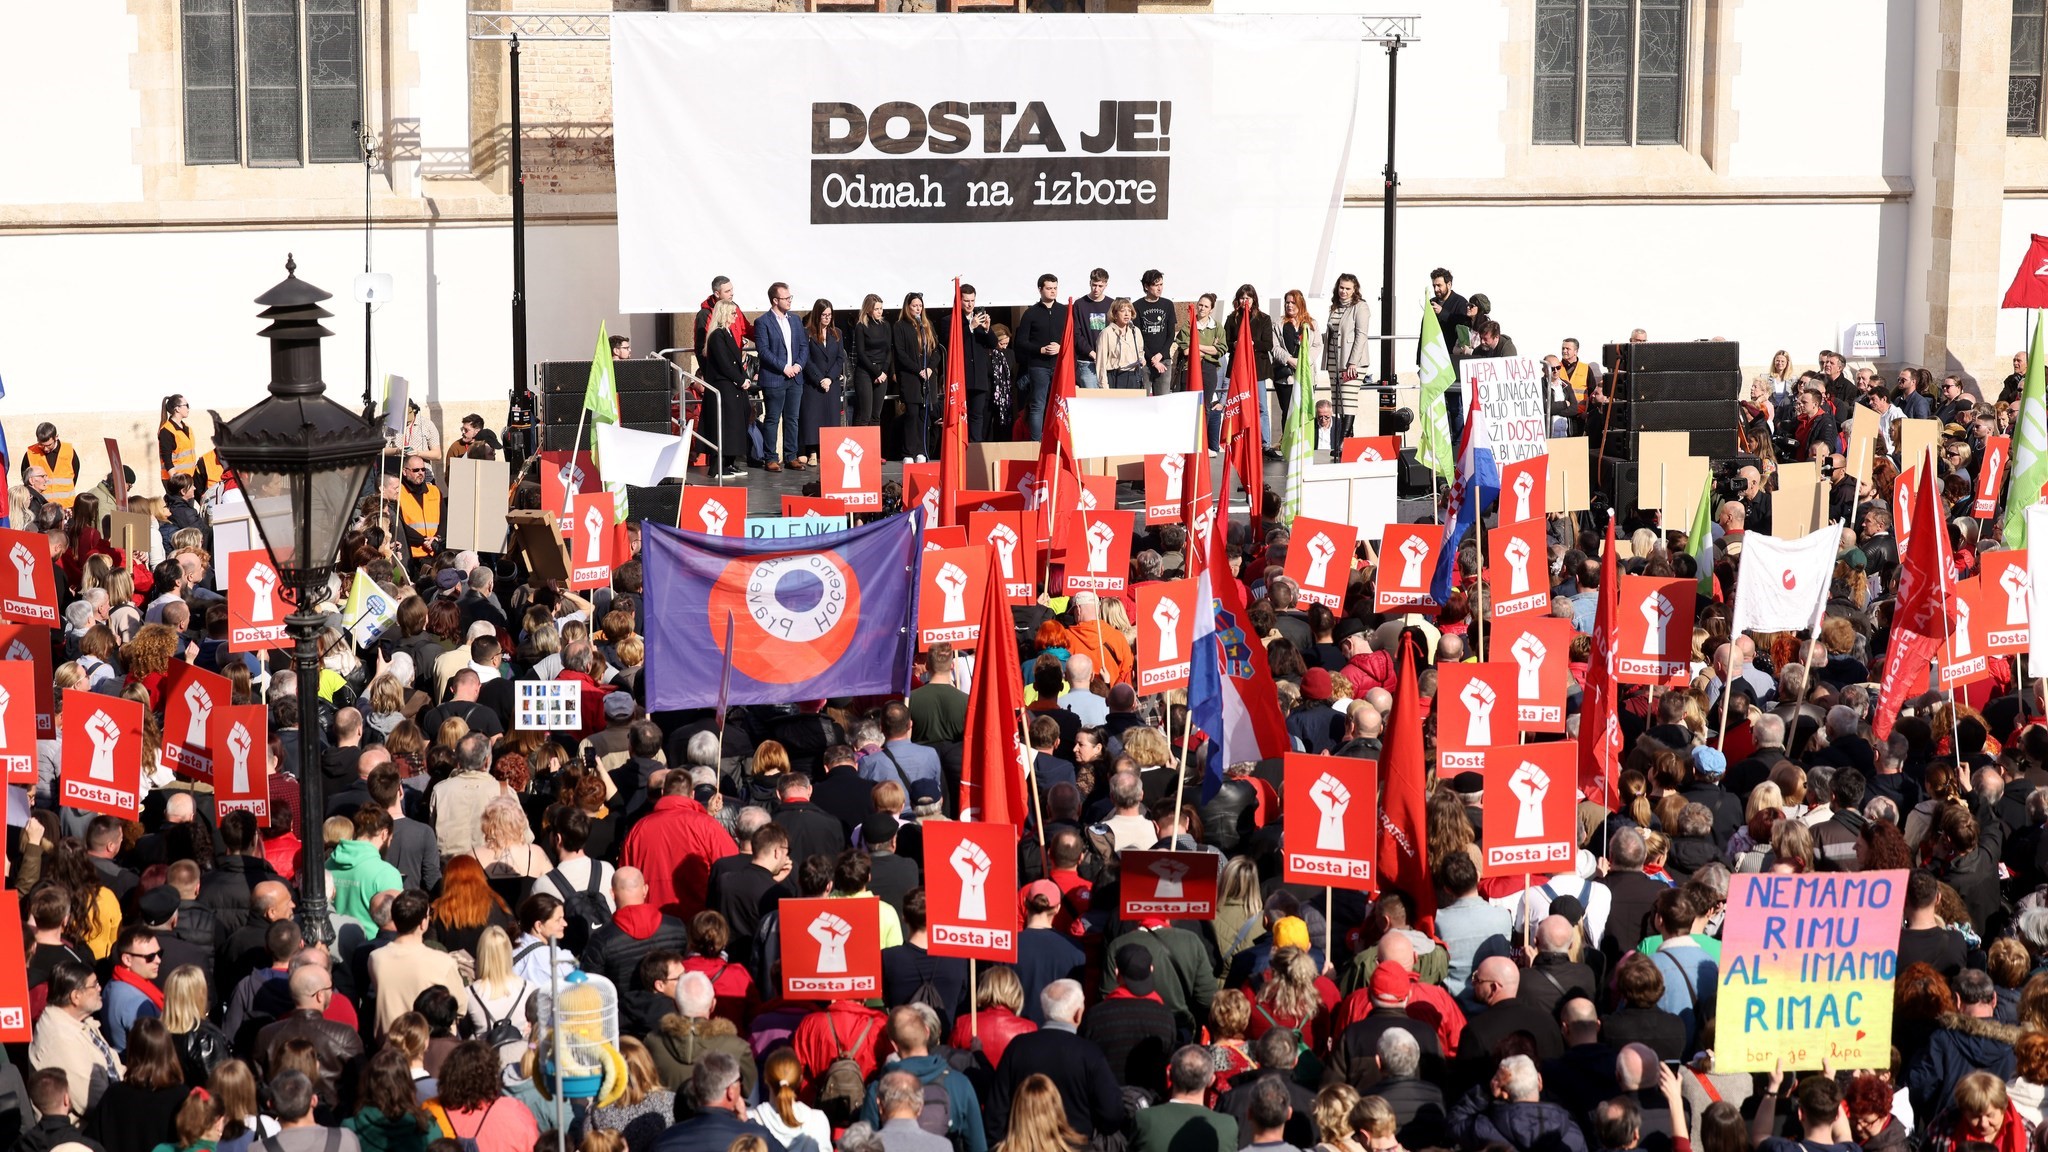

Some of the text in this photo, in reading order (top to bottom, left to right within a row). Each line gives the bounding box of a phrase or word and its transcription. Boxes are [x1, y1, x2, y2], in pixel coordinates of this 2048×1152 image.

[811, 100, 1172, 155] DOSTA JE!
[821, 171, 1157, 209] Odmah na izbore
[1505, 357, 1536, 380] NAŠA
[1496, 380, 1540, 402] JUNAČKA
[1481, 400, 1542, 420] MLJO MILA
[1507, 419, 1546, 442] DOSTA
[863, 494, 876, 504] je!
[575, 568, 608, 581] Dosta je!
[1015, 585, 1030, 596] je!
[1107, 578, 1122, 590] je!
[1298, 592, 1339, 607] osta je!
[1382, 594, 1435, 605] Dosta je
[1497, 595, 1545, 615] Dosta je!
[5, 601, 54, 619] Dosta je!
[235, 627, 287, 641] Dosta je
[925, 627, 980, 642] Dosta je
[1990, 634, 2028, 645] Dosta
[1144, 665, 1190, 684] Dosta je
[1621, 661, 1684, 676] Dosta je!
[1943, 658, 1985, 679] Dosta je!
[1518, 707, 1558, 721] sta je!
[10, 757, 29, 772] je!
[168, 745, 203, 769] Dosta
[68, 783, 132, 808] Dosta je!
[252, 802, 265, 815] je!
[1492, 845, 1567, 863] Dosta je!
[1293, 857, 1367, 878] Dosta je!
[1745, 875, 1893, 910] NEMAMO
[1129, 902, 1207, 912] Dosta je!
[935, 928, 1009, 948] Dosta je!
[1763, 915, 1860, 951] RIMU
[1723, 949, 1898, 987] AL' IMAMO
[792, 978, 872, 991] Dosta je!
[1744, 990, 1863, 1034] RIMAC
[1747, 1047, 1773, 1063] bar
[1788, 1048, 1807, 1065] je
